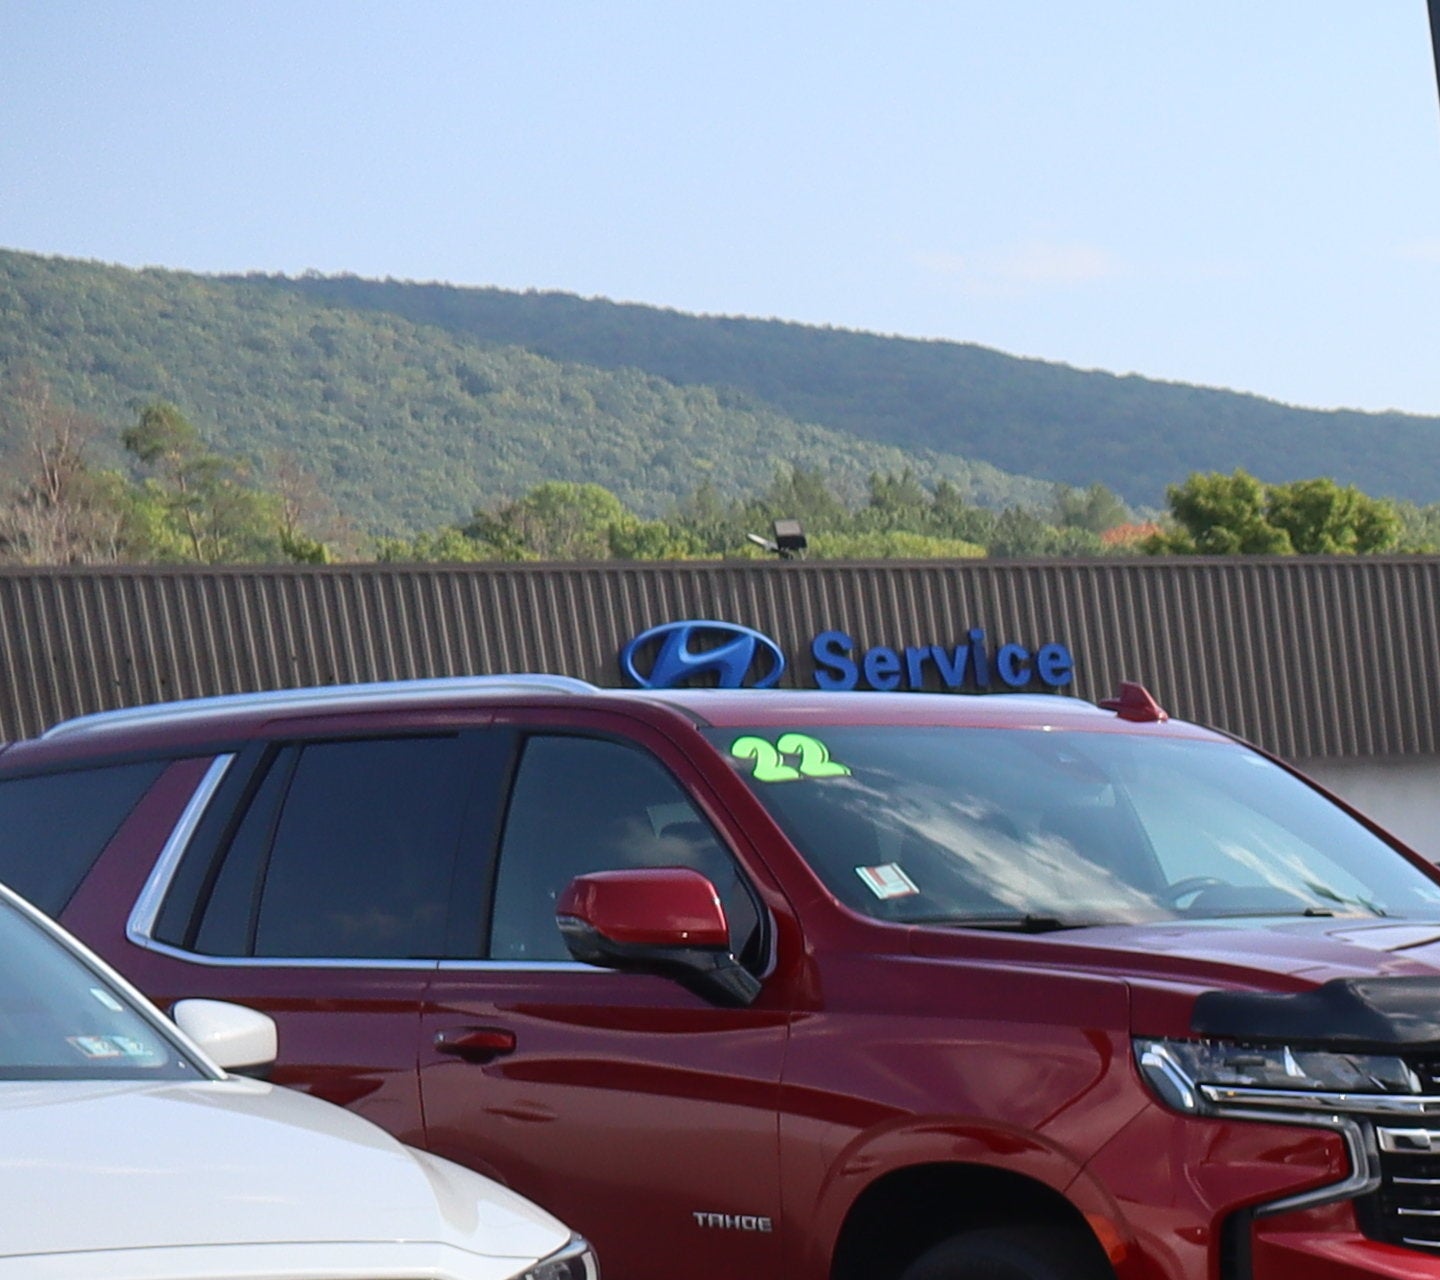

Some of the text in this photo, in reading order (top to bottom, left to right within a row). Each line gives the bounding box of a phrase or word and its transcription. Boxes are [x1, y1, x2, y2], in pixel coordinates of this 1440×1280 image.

[812, 629, 1074, 690] Service
[731, 732, 852, 782] 22
[692, 1210, 773, 1233] TAHOE
